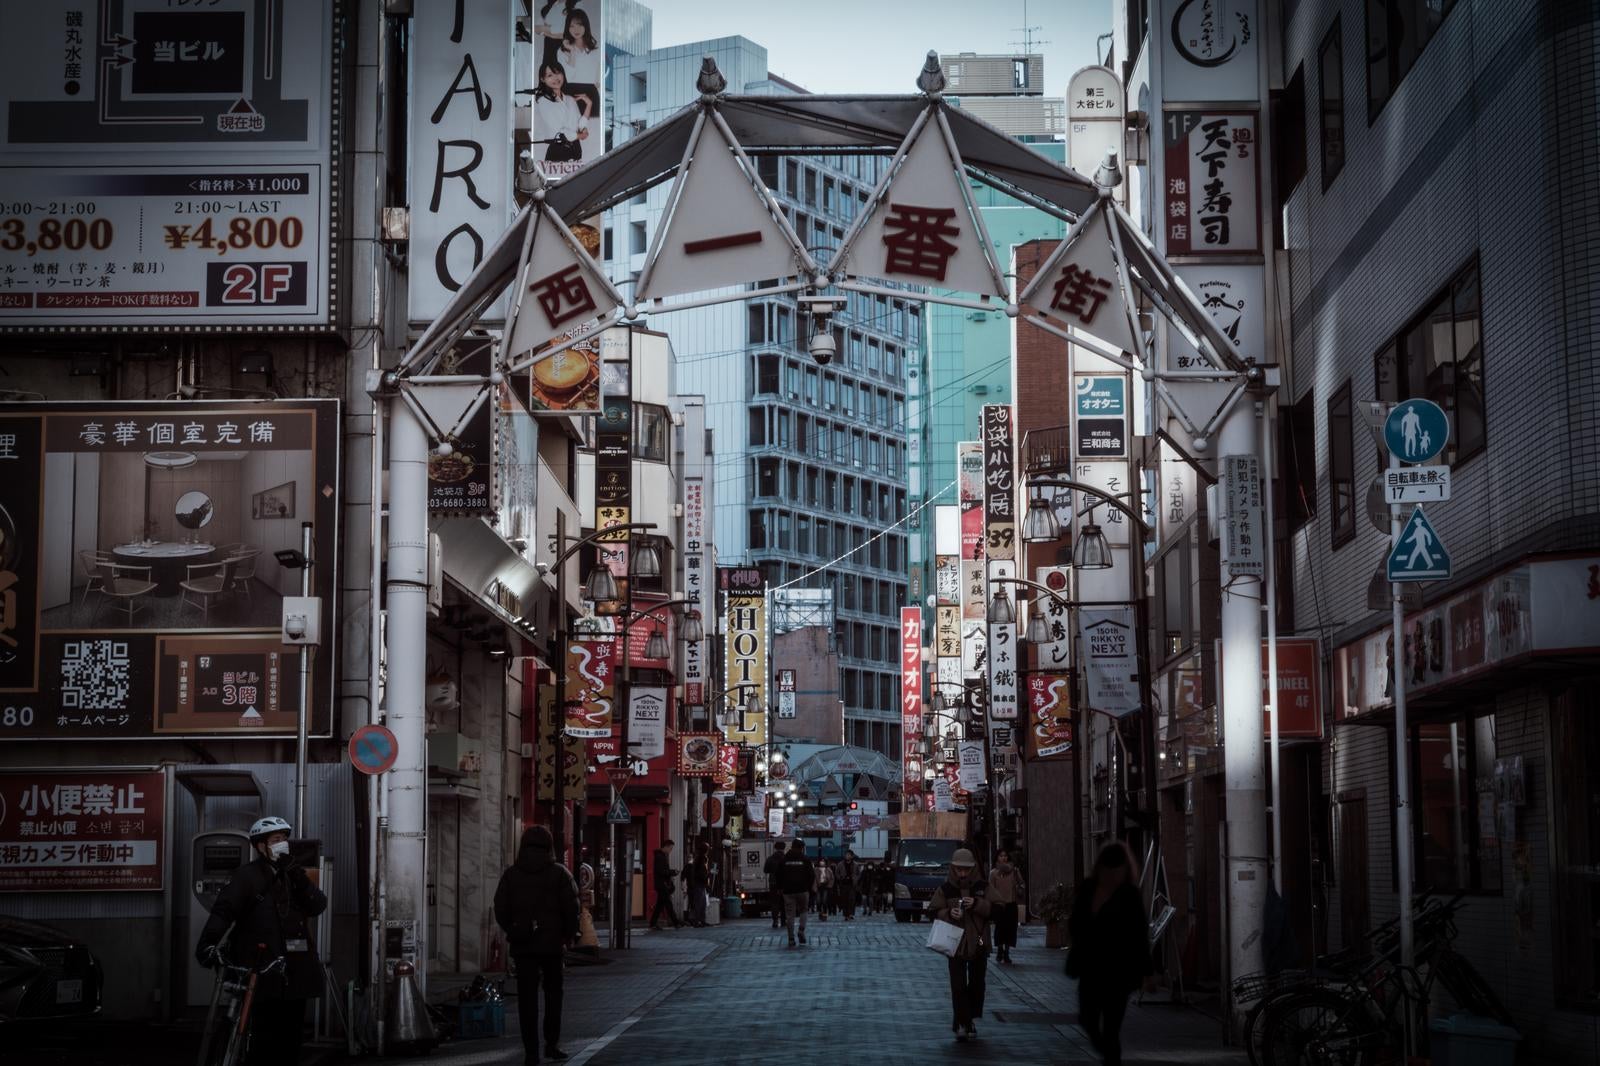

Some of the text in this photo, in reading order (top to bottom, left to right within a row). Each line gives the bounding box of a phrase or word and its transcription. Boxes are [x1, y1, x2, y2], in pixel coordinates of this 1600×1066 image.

[65, 11, 82, 80] 磯丸水産
[153, 40, 226, 63] 当ビル
[1086, 87, 1104, 97] 第三
[1076, 99, 1115, 109] 大谷ビル
[219, 116, 264, 131] 現在地
[1167, 113, 1192, 141] 1F
[1231, 127, 1253, 159] 廻る
[1195, 118, 1232, 245] 天下寿司
[1169, 177, 1188, 241] 池袋店
[163, 217, 305, 255] ¥4,800
[529, 203, 1114, 329] 西 一 番 街
[223, 264, 292, 304] 2F
[1081, 398, 1121, 409] オオタニ
[78, 421, 276, 447] 豪華個室完備
[1081, 438, 1121, 449] 三和商会
[1077, 465, 1091, 476] 1F
[1387, 472, 1446, 485] 自転車を除く
[1238, 458, 1251, 558] 防犯カメラ作動中
[688, 539, 701, 603] 中華そば
[1090, 634, 1126, 643] RIKKYO
[1091, 643, 1126, 654] NEXT
[223, 671, 259, 684] 当ビル
[780, 684, 795, 692] KFC
[221, 684, 257, 705] 3階
[2, 706, 35, 727] 80
[57, 712, 130, 726] ホームページ
[19, 782, 146, 817] 小便禁止
[19, 820, 78, 837] 禁止小便
[86, 819, 146, 836] 소변 금지
[0, 843, 134, 865] 視カメラ作動中
